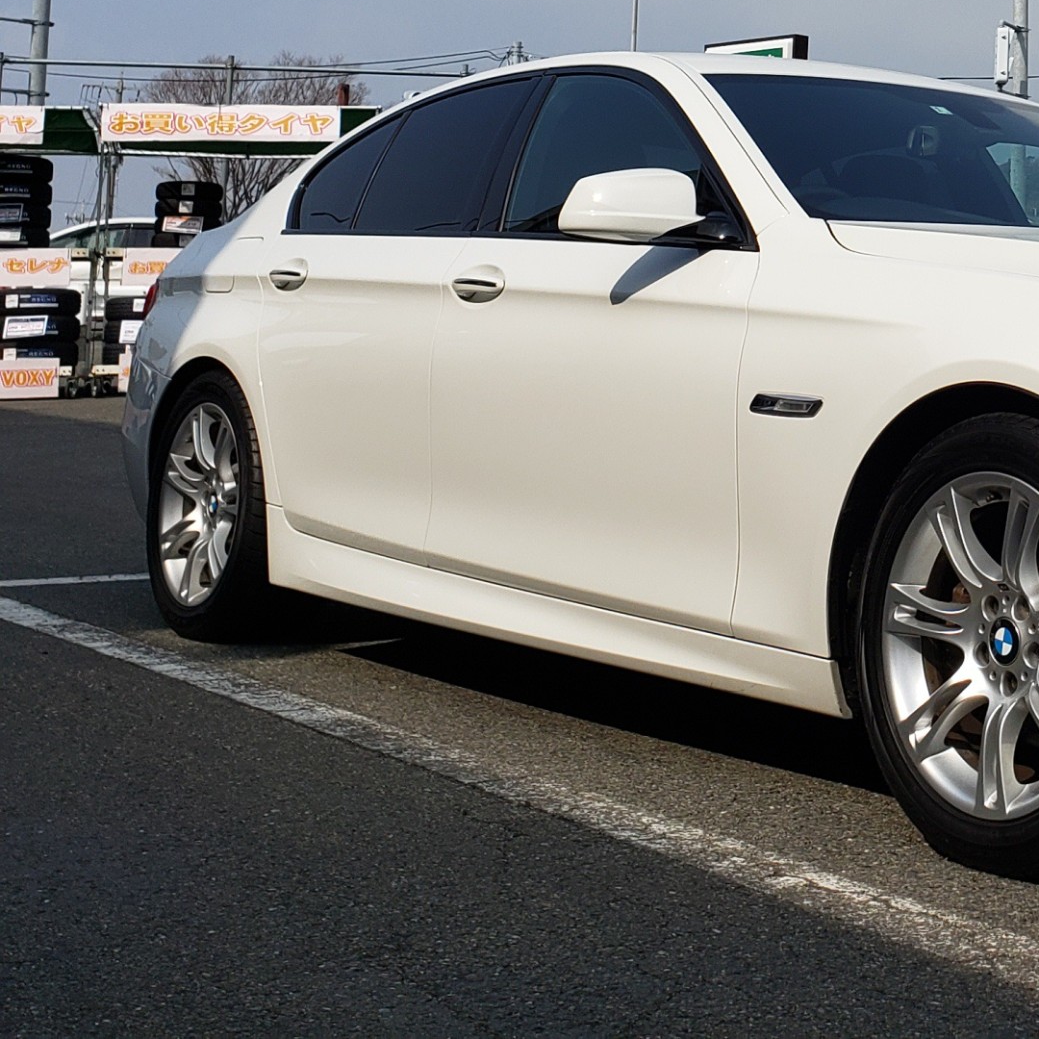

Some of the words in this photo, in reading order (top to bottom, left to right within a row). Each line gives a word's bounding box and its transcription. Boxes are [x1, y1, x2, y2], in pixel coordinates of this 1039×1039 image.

[110, 110, 334, 134] お買い得タイヤ
[3, 257, 69, 274] セレナ
[0, 369, 55, 388] VOXY
